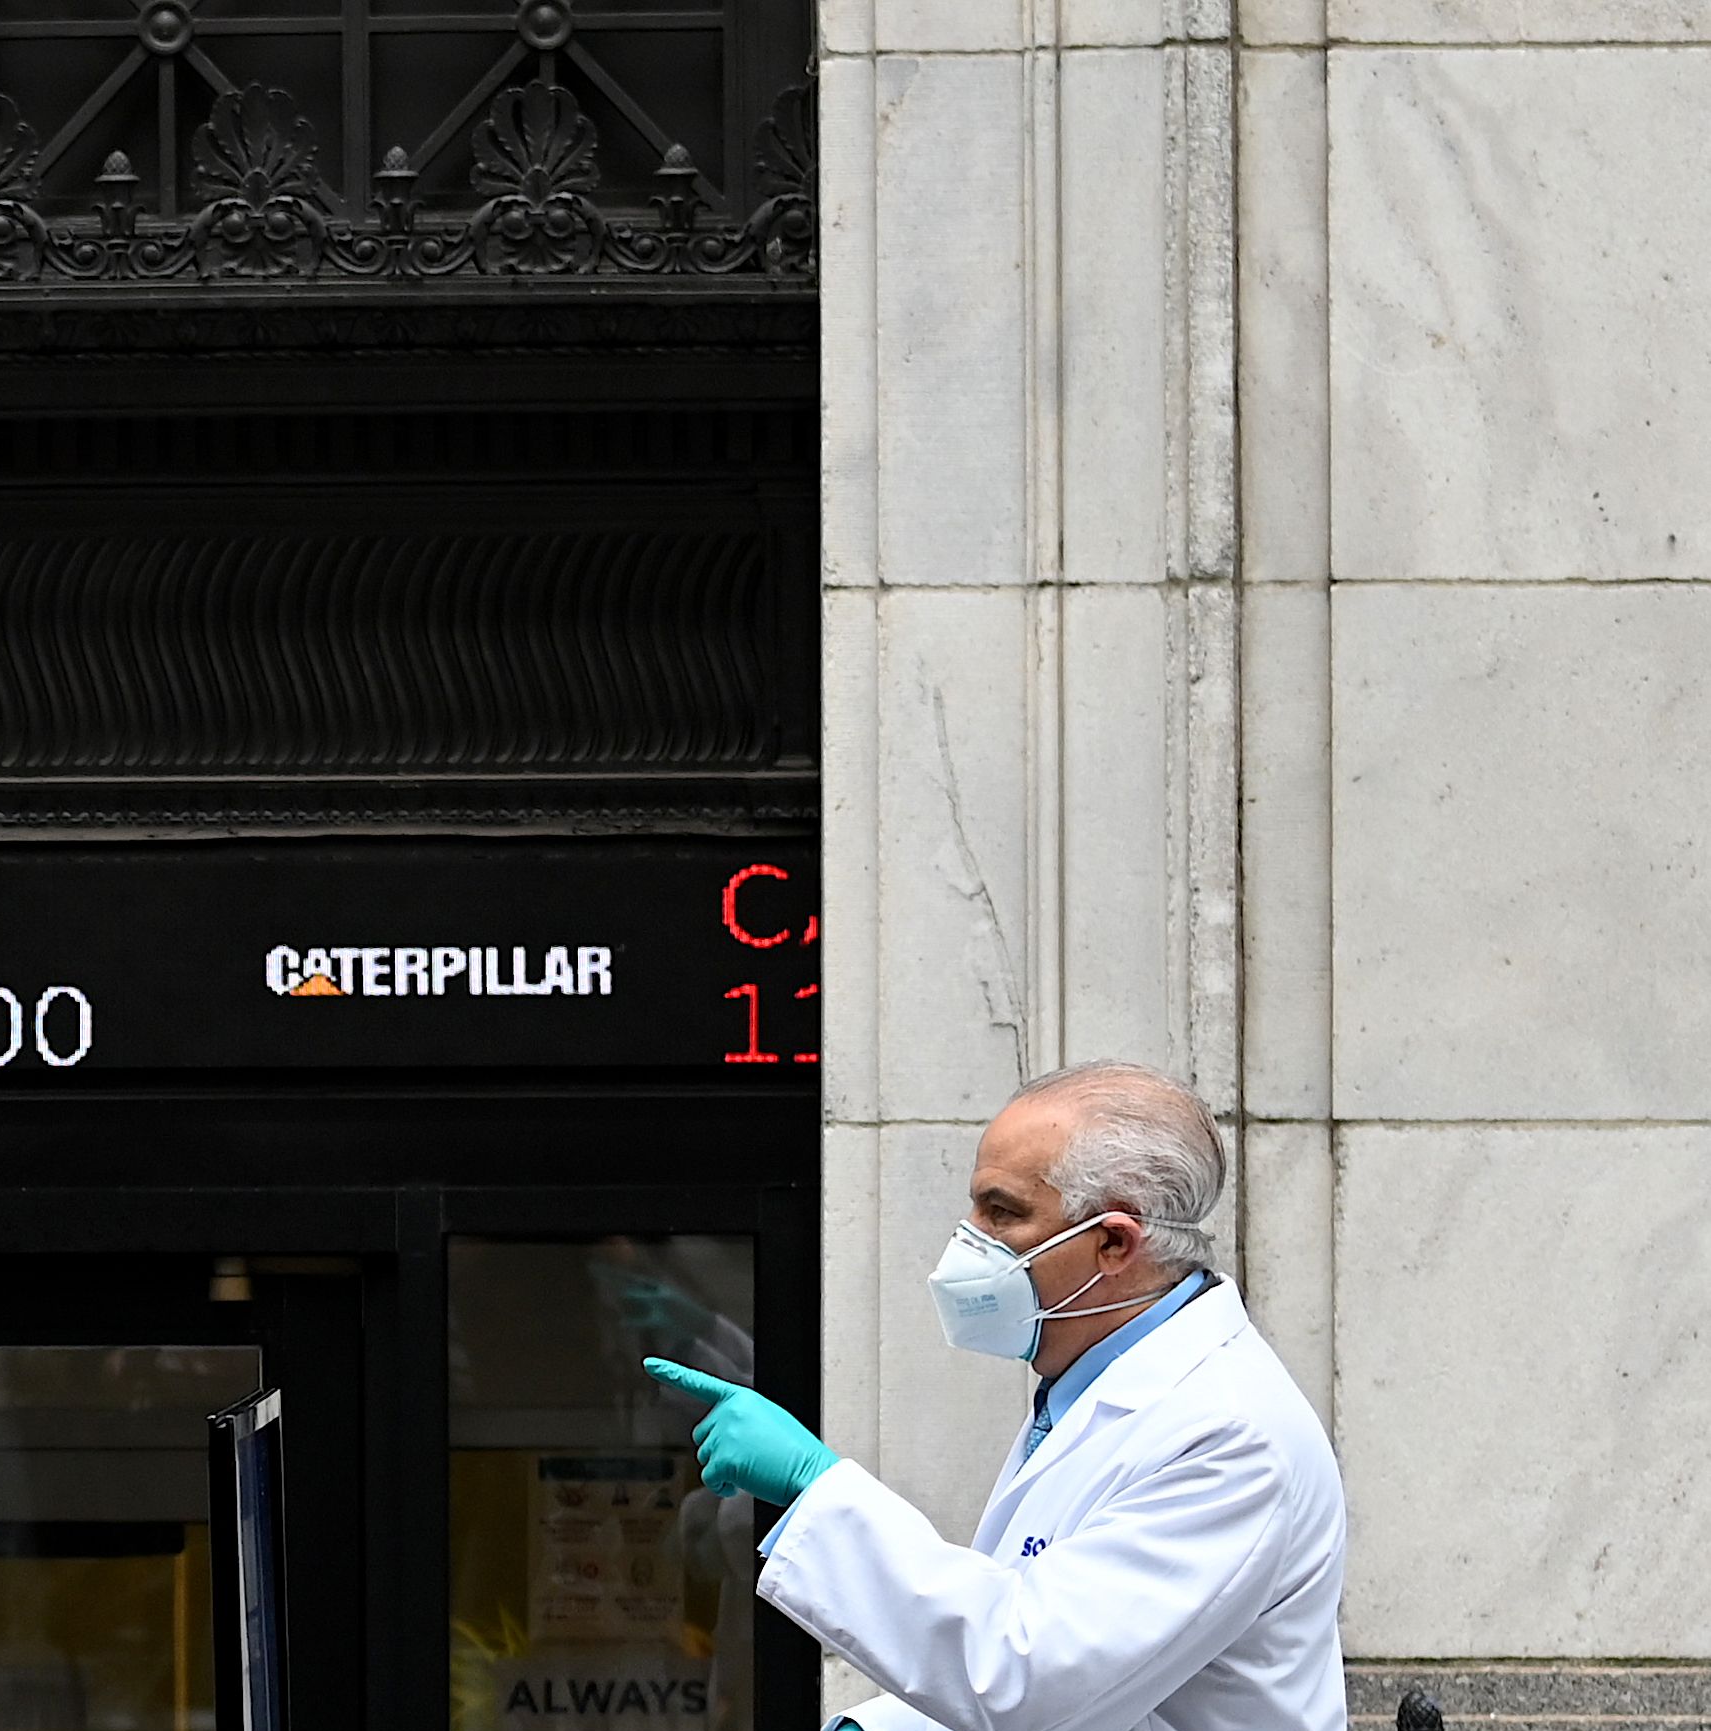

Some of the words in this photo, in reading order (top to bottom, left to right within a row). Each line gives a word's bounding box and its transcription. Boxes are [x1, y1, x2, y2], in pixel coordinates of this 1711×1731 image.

[722, 864, 818, 949] C
[265, 945, 612, 996] CATERPILLAR
[506, 1679, 708, 1715] ALWAYS
